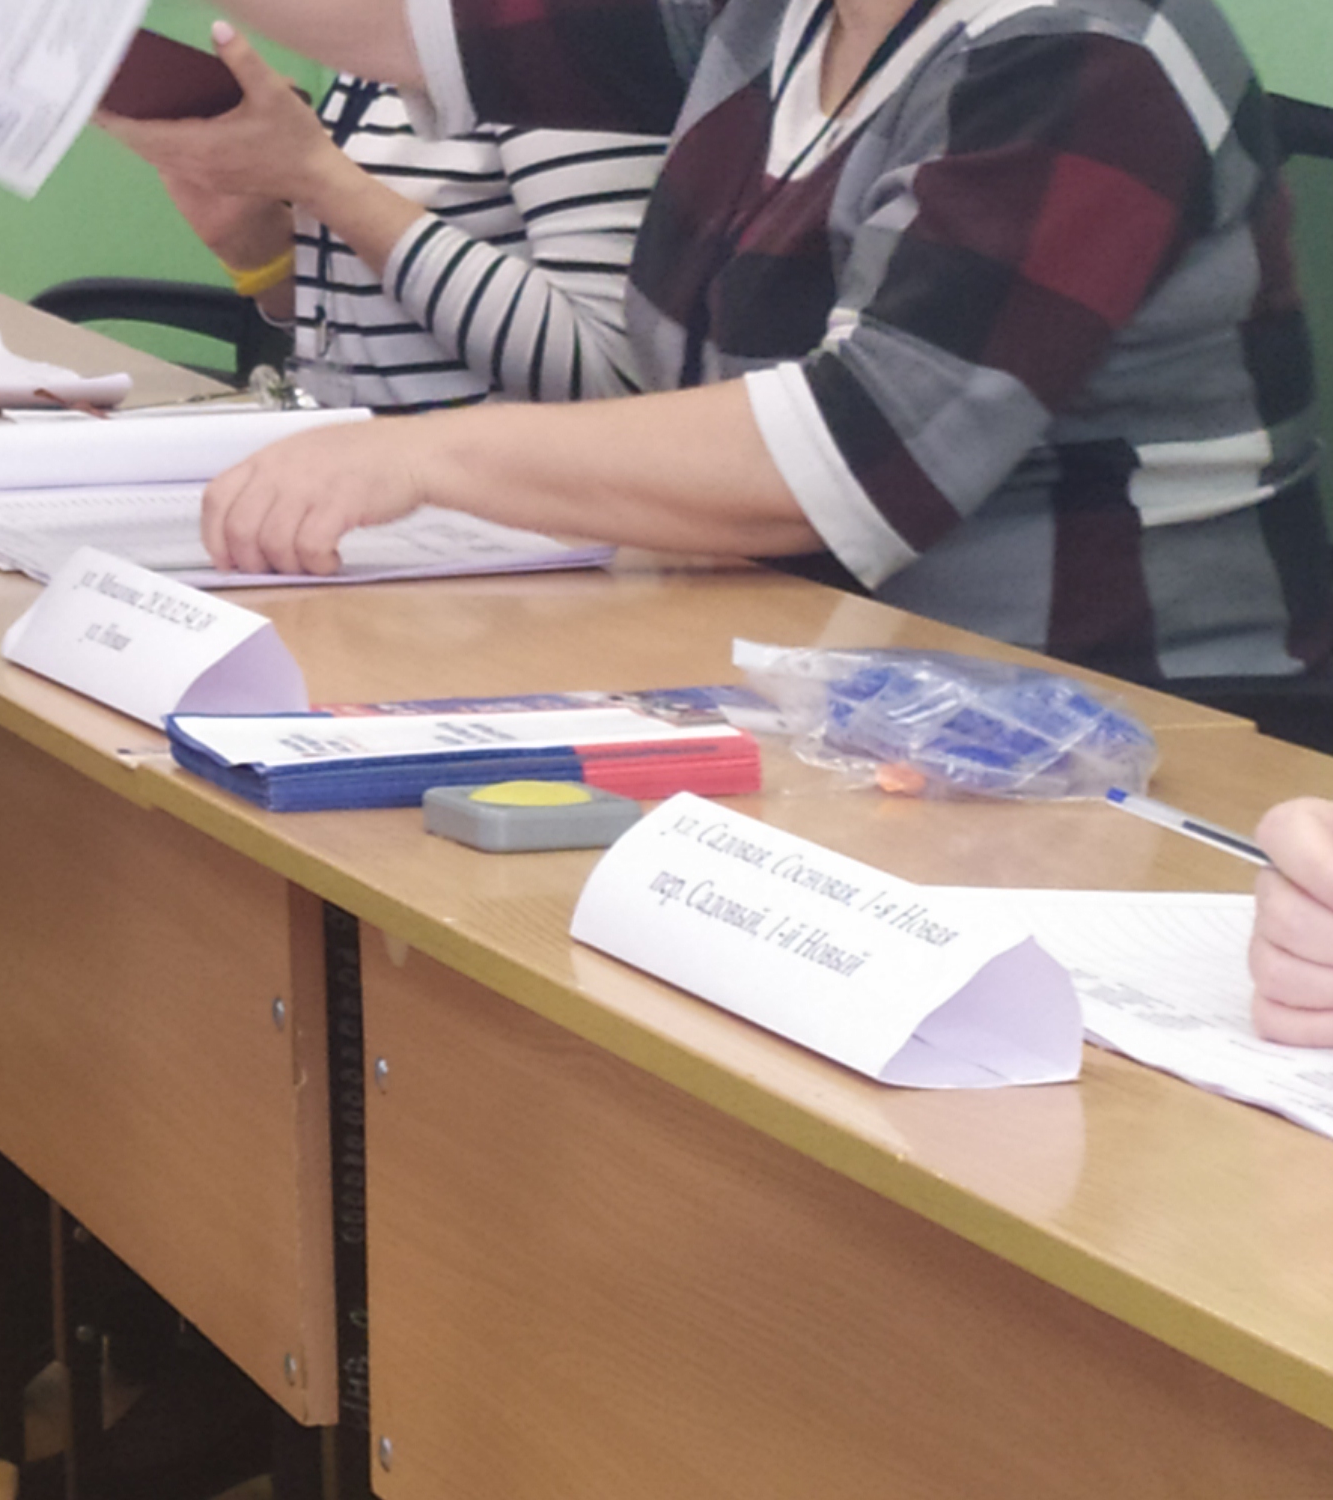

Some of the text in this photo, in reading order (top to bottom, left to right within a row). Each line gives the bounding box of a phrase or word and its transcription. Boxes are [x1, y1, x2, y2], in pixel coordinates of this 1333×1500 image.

[685, 879, 773, 937] Садовый,
[793, 928, 873, 978] Новый
[888, 903, 959, 947] Новая
